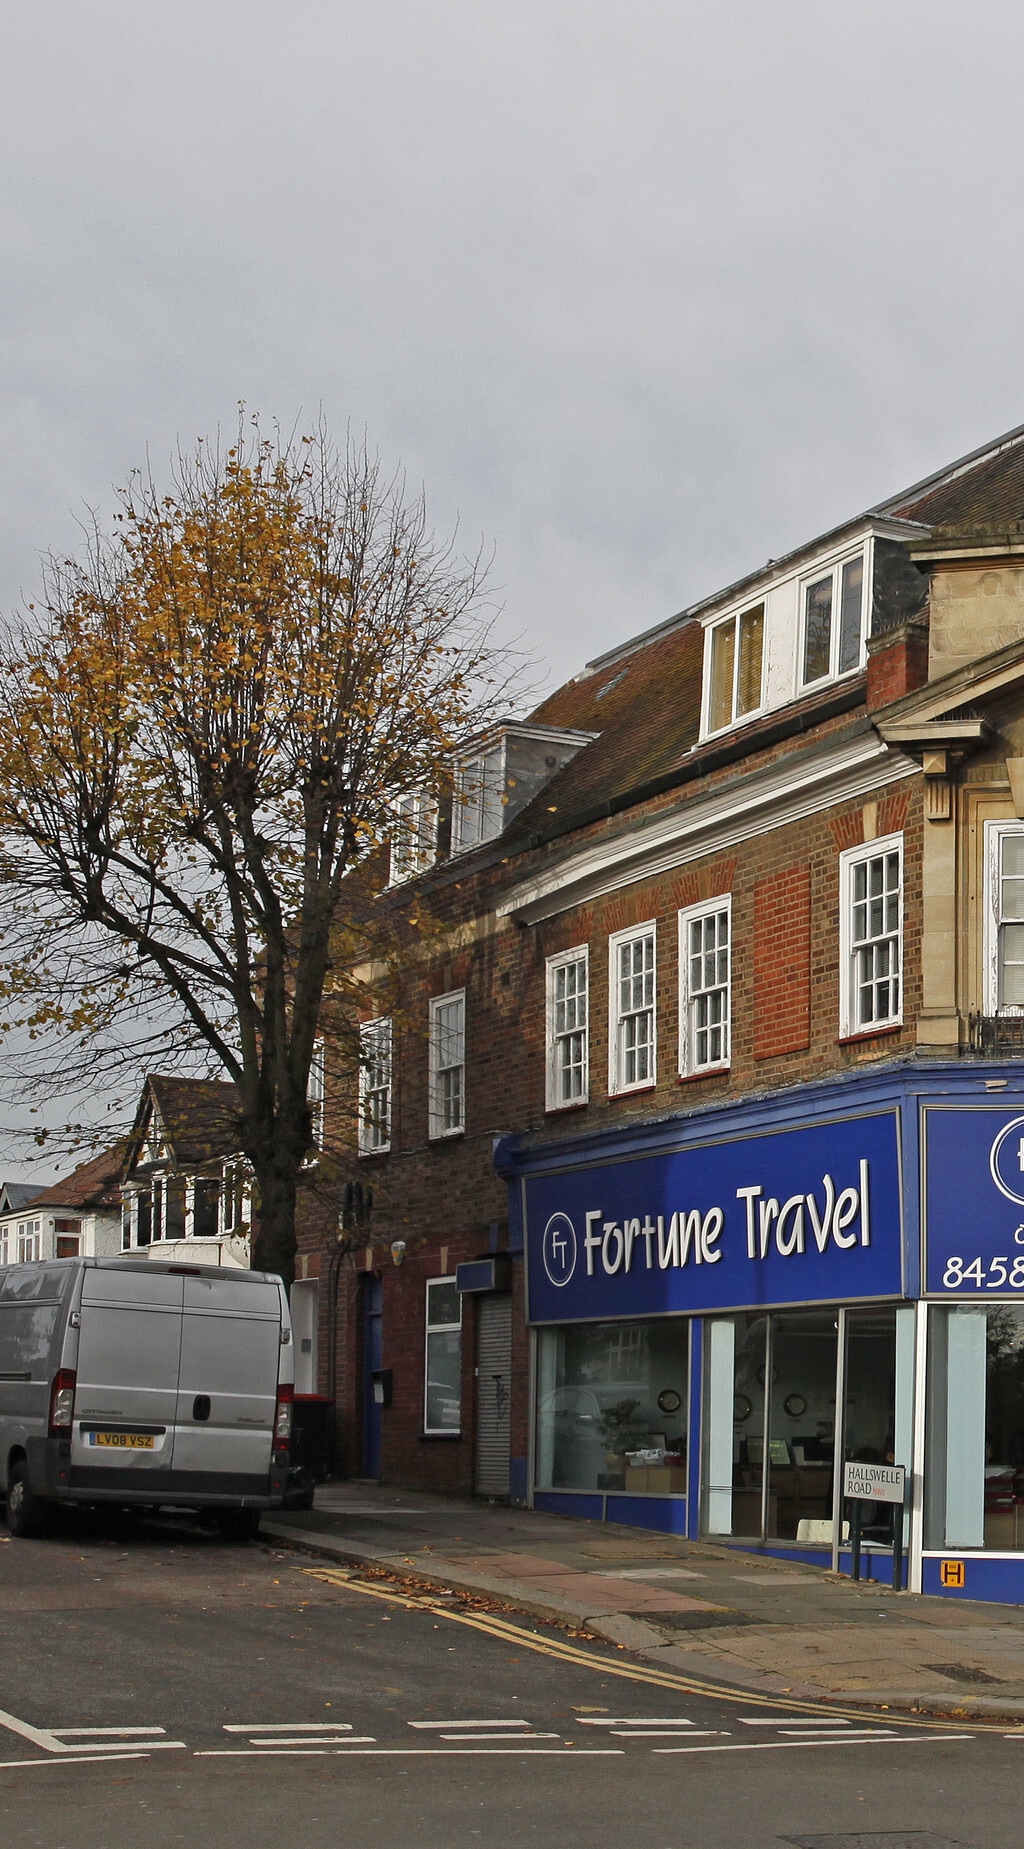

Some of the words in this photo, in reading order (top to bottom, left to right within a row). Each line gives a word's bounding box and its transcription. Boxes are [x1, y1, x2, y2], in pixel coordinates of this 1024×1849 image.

[584, 1210, 724, 1276] Fortune
[736, 1159, 870, 1260] Travel
[96, 1433, 127, 1445] LV08
[129, 1435, 152, 1447] VSZ
[848, 1467, 900, 1484] HALLSWELLE
[848, 1480, 872, 1495] ROAD
[945, 1563, 960, 1584] H
